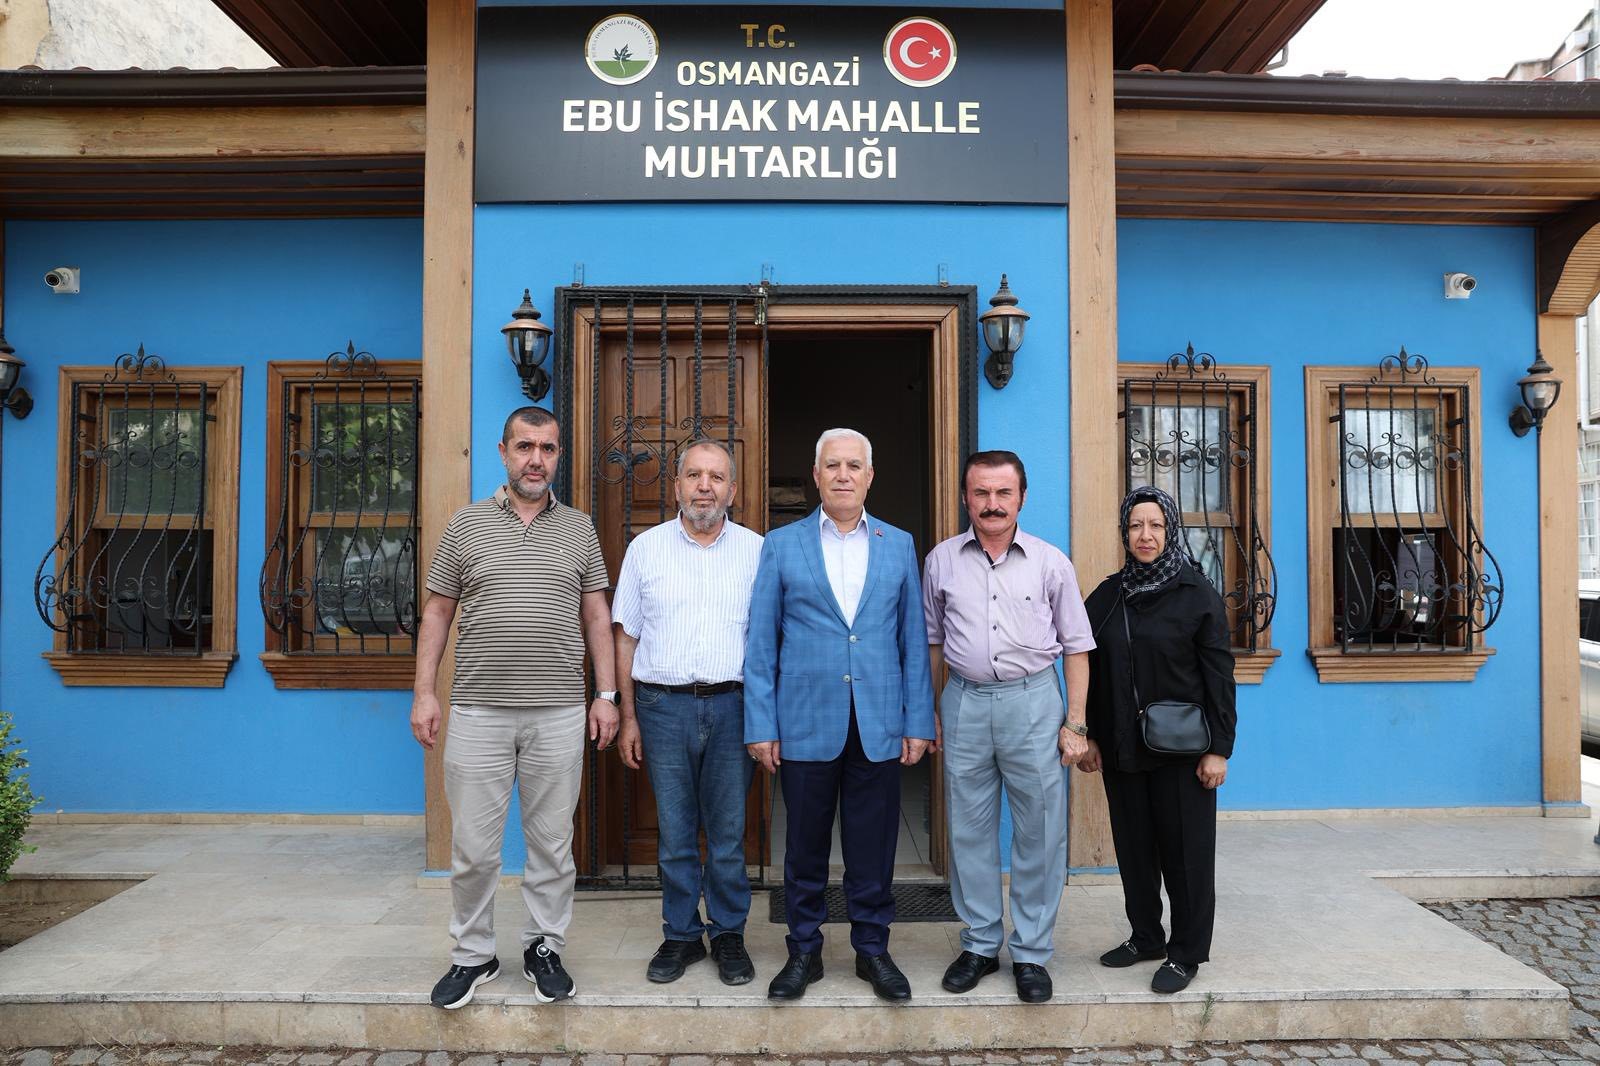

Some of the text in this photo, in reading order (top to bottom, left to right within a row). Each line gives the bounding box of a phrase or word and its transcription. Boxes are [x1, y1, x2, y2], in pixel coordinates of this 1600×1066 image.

[740, 23, 796, 49] T.C.
[676, 56, 861, 87] OSMANGAZİ
[562, 90, 981, 134] EBU İSHAK MAHALLE
[644, 136, 898, 180] MUHTARLIĞI
